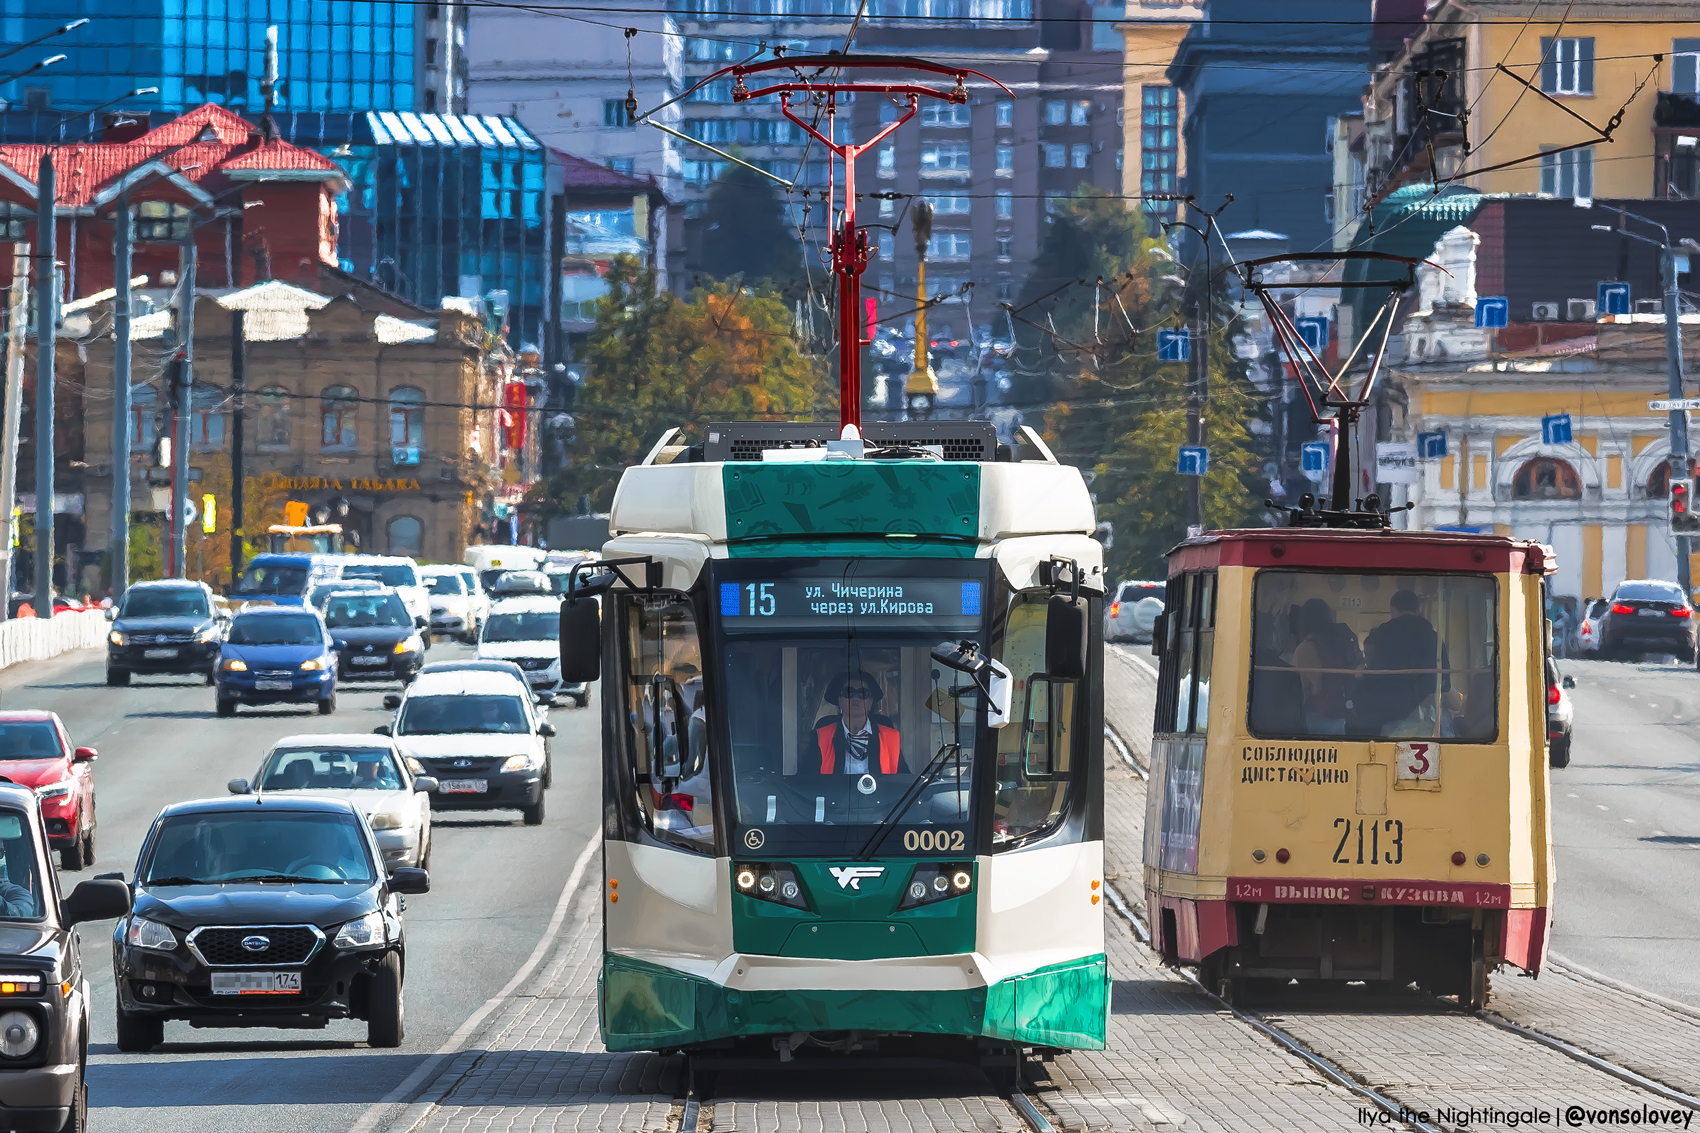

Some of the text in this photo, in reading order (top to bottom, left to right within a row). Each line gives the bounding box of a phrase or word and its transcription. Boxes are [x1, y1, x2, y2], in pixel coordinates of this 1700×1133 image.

[745, 583, 776, 616] 15
[805, 583, 903, 599] ул. Чичерина
[811, 601, 854, 615] через
[1341, 598, 1362, 607] 2113
[1242, 746, 1338, 765] СОБЛЮДАЙ
[1408, 744, 1430, 775] 3
[903, 830, 965, 851] 0002
[1332, 818, 1403, 865] 2113
[1275, 885, 1350, 900] ВЫНОС
[1380, 887, 1465, 903] КУЗОВА
[275, 974, 298, 985] 174
